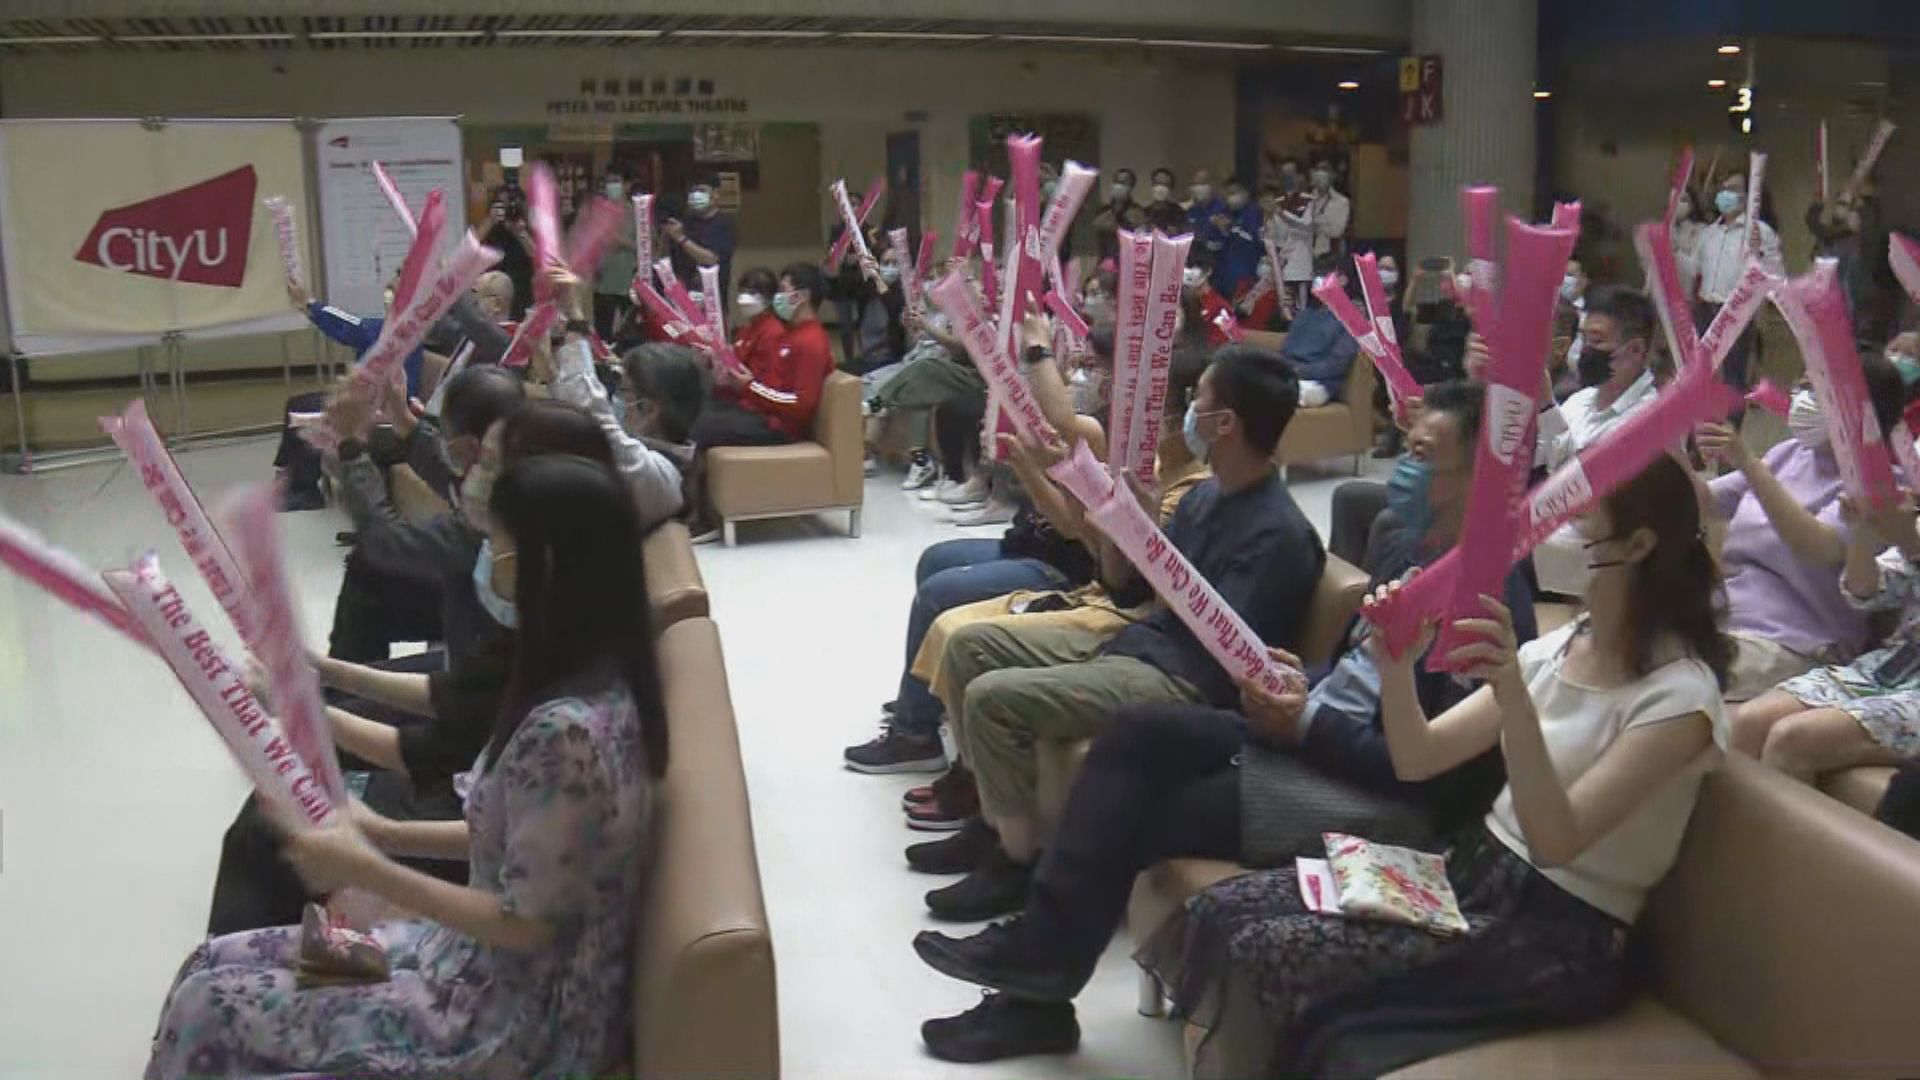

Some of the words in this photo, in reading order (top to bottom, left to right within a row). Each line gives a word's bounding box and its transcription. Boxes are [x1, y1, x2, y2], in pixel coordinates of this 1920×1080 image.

[1424, 61, 1435, 82] F
[621, 99, 682, 113] LECTURE
[688, 98, 749, 113] THEATRE
[97, 227, 228, 281] CityU
[1160, 283, 1178, 304] Be
[1155, 310, 1176, 340] Can
[1151, 344, 1170, 370] We
[1145, 377, 1168, 412] That
[1139, 418, 1160, 452] Best
[1499, 398, 1522, 458] CityU
[1535, 479, 1583, 518] CityU
[1145, 531, 1167, 565] Be
[1163, 552, 1191, 592] Can
[1187, 583, 1210, 619] We
[1206, 607, 1241, 650] That
[1231, 639, 1265, 680] Best
[152, 583, 193, 630] The
[184, 629, 230, 682] Best
[220, 677, 270, 737] That
[263, 736, 299, 776] We
[290, 774, 331, 826] Can
